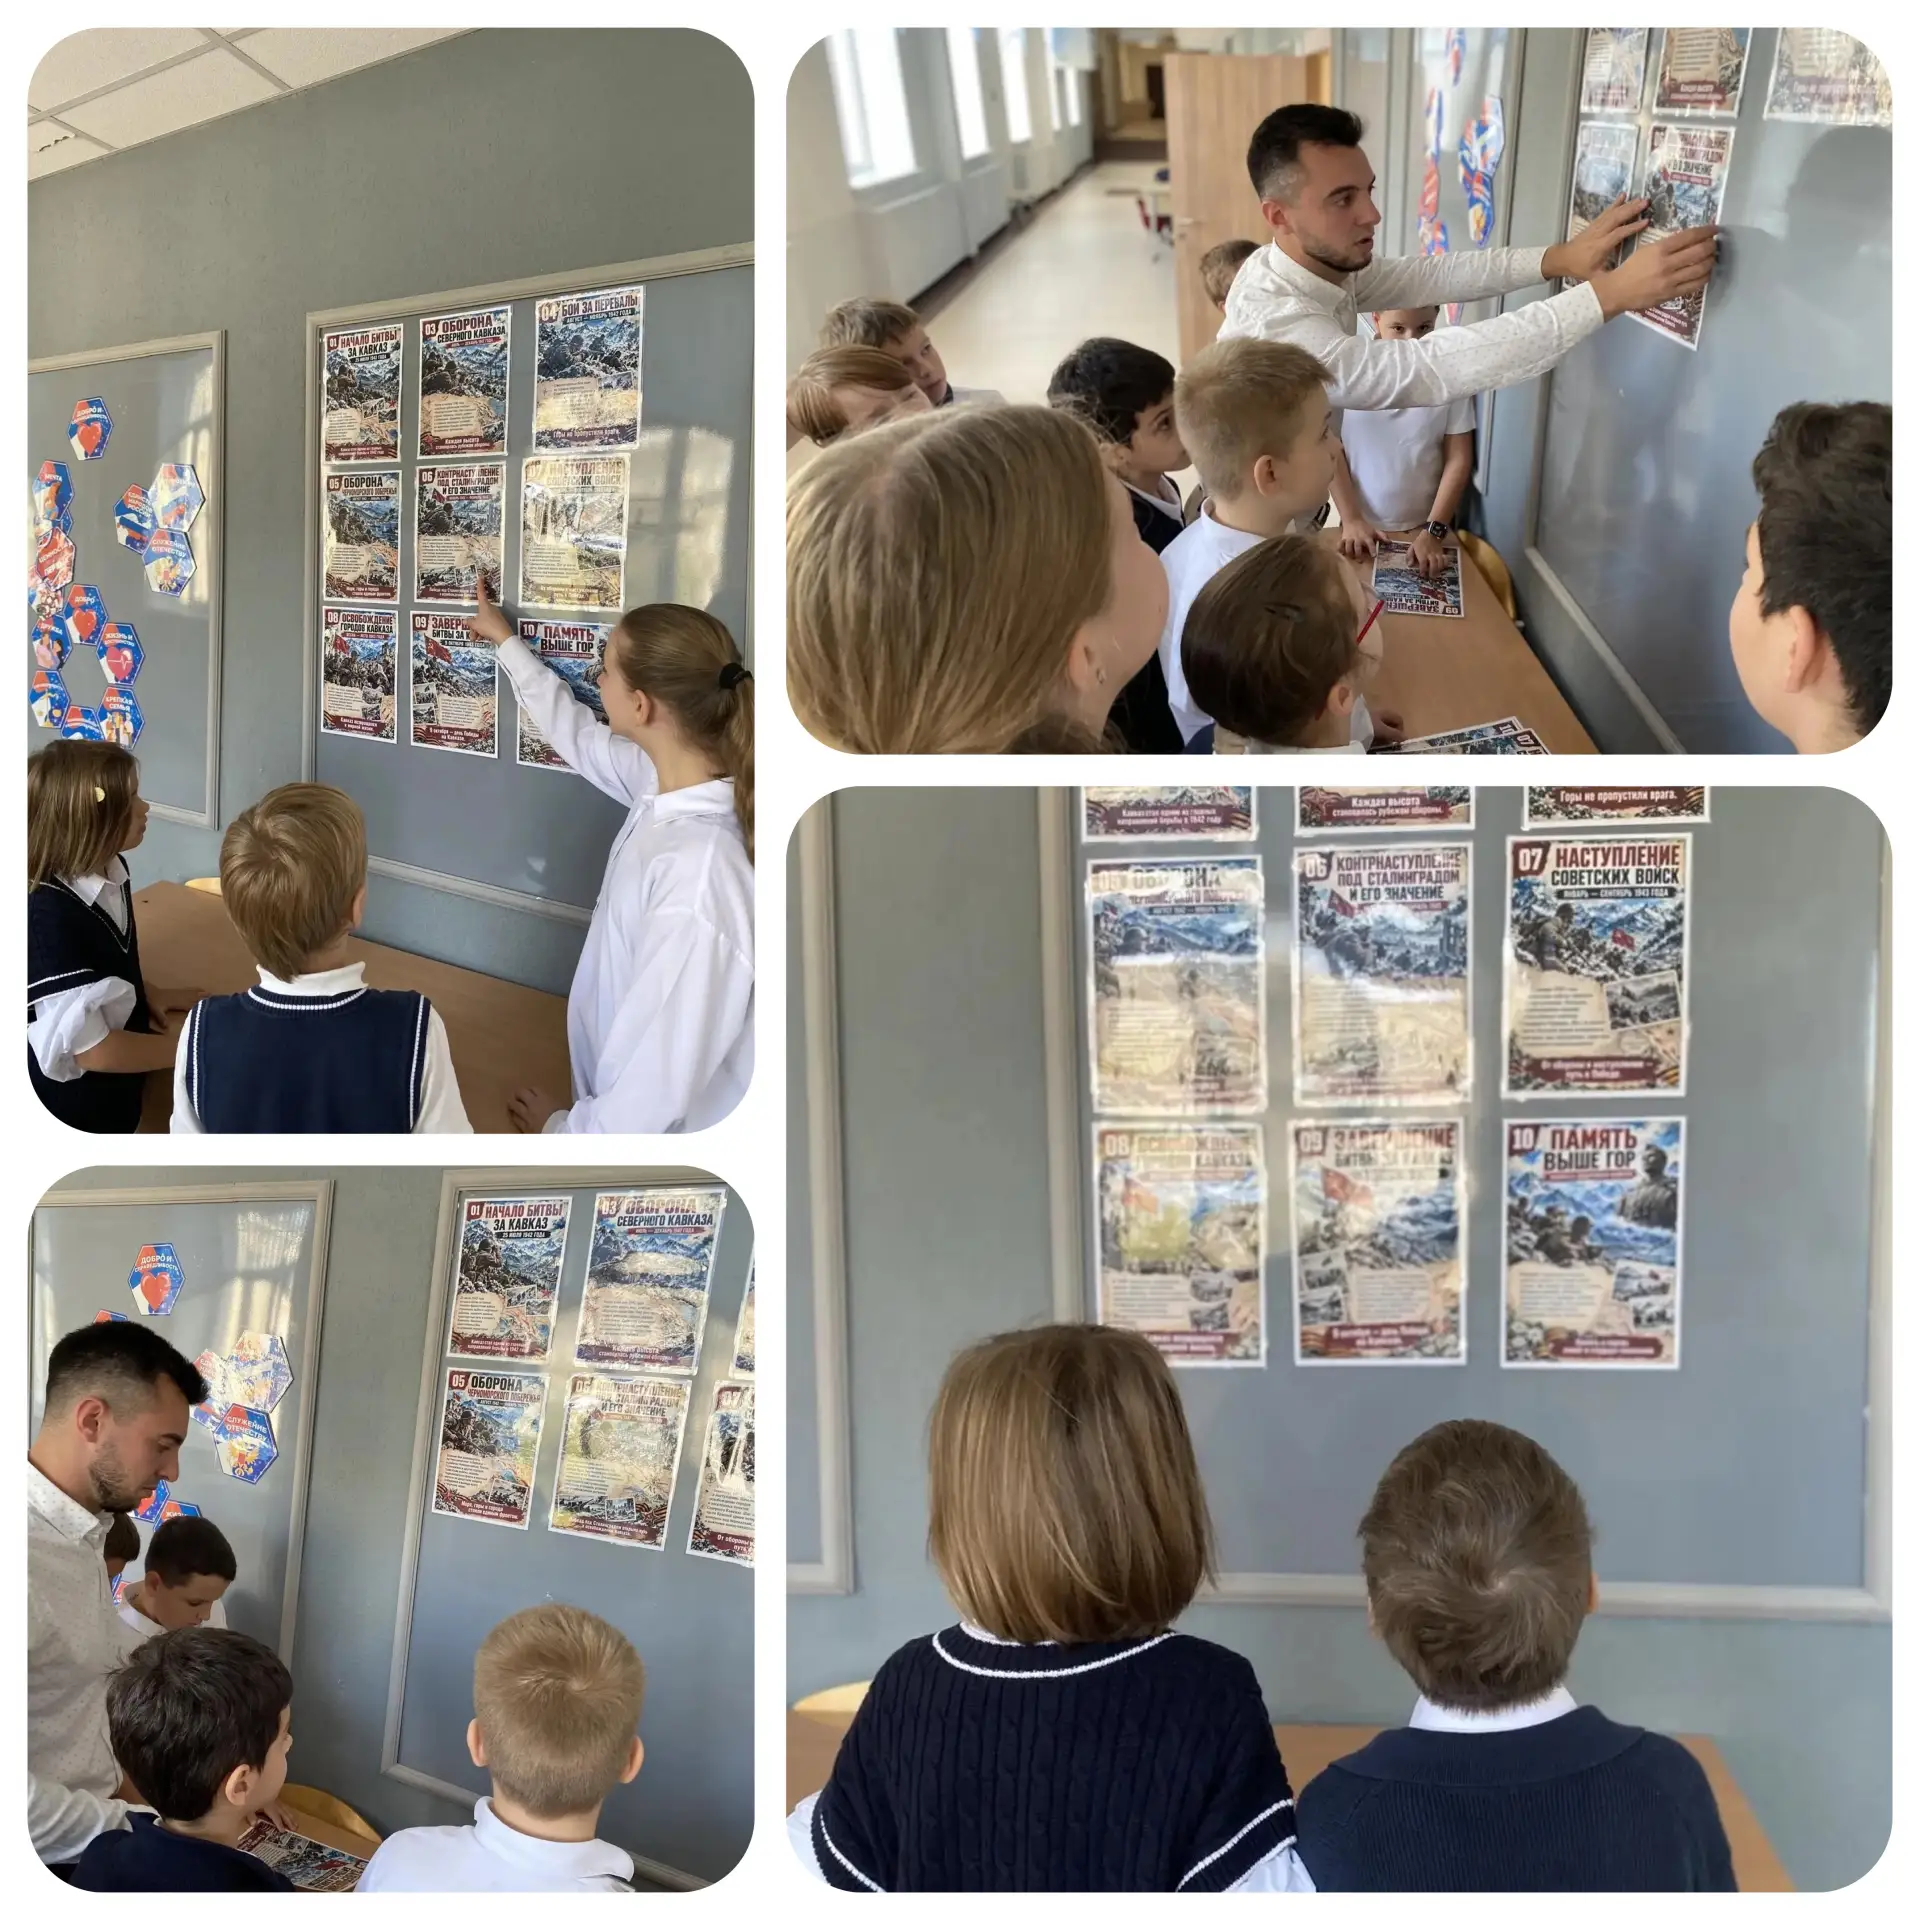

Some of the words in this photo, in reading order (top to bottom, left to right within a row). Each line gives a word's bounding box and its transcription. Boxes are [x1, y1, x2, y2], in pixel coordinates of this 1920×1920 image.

[562, 303, 579, 316] БОИ
[582, 302, 592, 313] ЗА
[595, 295, 637, 311] ПЕРЕВАЛЫ
[425, 324, 436, 335] 03
[442, 315, 492, 333] ОБОРОНА
[341, 334, 369, 348] НАЧАЛО
[372, 330, 397, 341] БИТВЫ
[438, 331, 471, 343] СЕВЕРНОГО
[474, 326, 505, 338] КАВКАЗА
[330, 338, 337, 347] 01
[348, 348, 356, 357] ЗА
[359, 342, 387, 355] КАВКАЗ
[422, 471, 433, 481] 06
[452, 477, 498, 486] СТАЛИНГРАДОМ
[330, 479, 339, 489] 05
[344, 477, 383, 488] ОБОРОНА
[460, 486, 490, 494] ЗНАЧЕНИЕ
[152, 547, 186, 557] ОТЕЧЕСТВУ
[1387, 602, 1439, 612] ЗАВЕРШЕН
[328, 612, 338, 622] 08
[342, 614, 392, 624] ОСВОБОЖДЕНИЕ
[416, 617, 426, 628] 09
[341, 623, 365, 632] ГОРОДОВ
[367, 625, 393, 633] КАВКАЗА
[432, 617, 471, 630] ЗАВЕРШ
[523, 624, 534, 635] 10
[433, 630, 454, 638] БИТВЫ
[456, 631, 464, 639] ЗА
[544, 626, 594, 641] ПАМЯТЬ
[541, 639, 572, 651] ВЫШЕ
[577, 642, 593, 652] ГОР
[1517, 735, 1534, 744] 07
[1352, 798, 1386, 807] Каждая
[1388, 797, 1420, 806] высота
[1560, 791, 1583, 804] Горы
[1585, 793, 1595, 801] не
[1597, 790, 1648, 803] пропустили
[1650, 790, 1677, 803] врага.
[1332, 809, 1376, 817] становилась
[1519, 848, 1543, 870] 07
[1556, 845, 1680, 868] НАСТУПЛЕНИЕ
[1305, 856, 1327, 878] 06
[1338, 874, 1363, 887] ПОД
[1368, 870, 1459, 885] СТАЛИНГРАДОМ
[1551, 869, 1630, 885] СОВЕТСКИХ
[1636, 868, 1679, 884] ВОЙСК
[1350, 889, 1357, 900] И
[1361, 888, 1380, 901] ЕГО
[1385, 886, 1444, 899] ЗНАЧЕНИЕ
[1600, 889, 1632, 897] СЕНТЯБРЬ
[1512, 1128, 1534, 1149] 10
[1552, 1128, 1637, 1149] ПАМЯТЬ
[1105, 1135, 1129, 1156] 08
[1544, 1151, 1599, 1170] ВЫШЕ
[1607, 1151, 1636, 1167] ГОР
[471, 1205, 480, 1215] 01
[486, 1205, 524, 1218] НАЧАЛО
[527, 1204, 563, 1216] БИТВЫ
[494, 1219, 505, 1230] ЗА
[509, 1218, 548, 1229] КАВКАЗ
[617, 1216, 665, 1226] СЕВЕРНОГО
[668, 1214, 713, 1226] КАВКАЗА
[453, 1375, 465, 1386] 05
[471, 1376, 522, 1391] ОБОРОНА
[468, 1389, 509, 1399] ЧЕРНОМОРСКОГО
[610, 1403, 623, 1412] ЕГО
[625, 1406, 666, 1416] ЗНАЧЕНИЕ
[228, 1416, 267, 1433] СЛУЖЕНИЕ
[227, 1424, 267, 1441] ОТЕЧЕСТВУ
